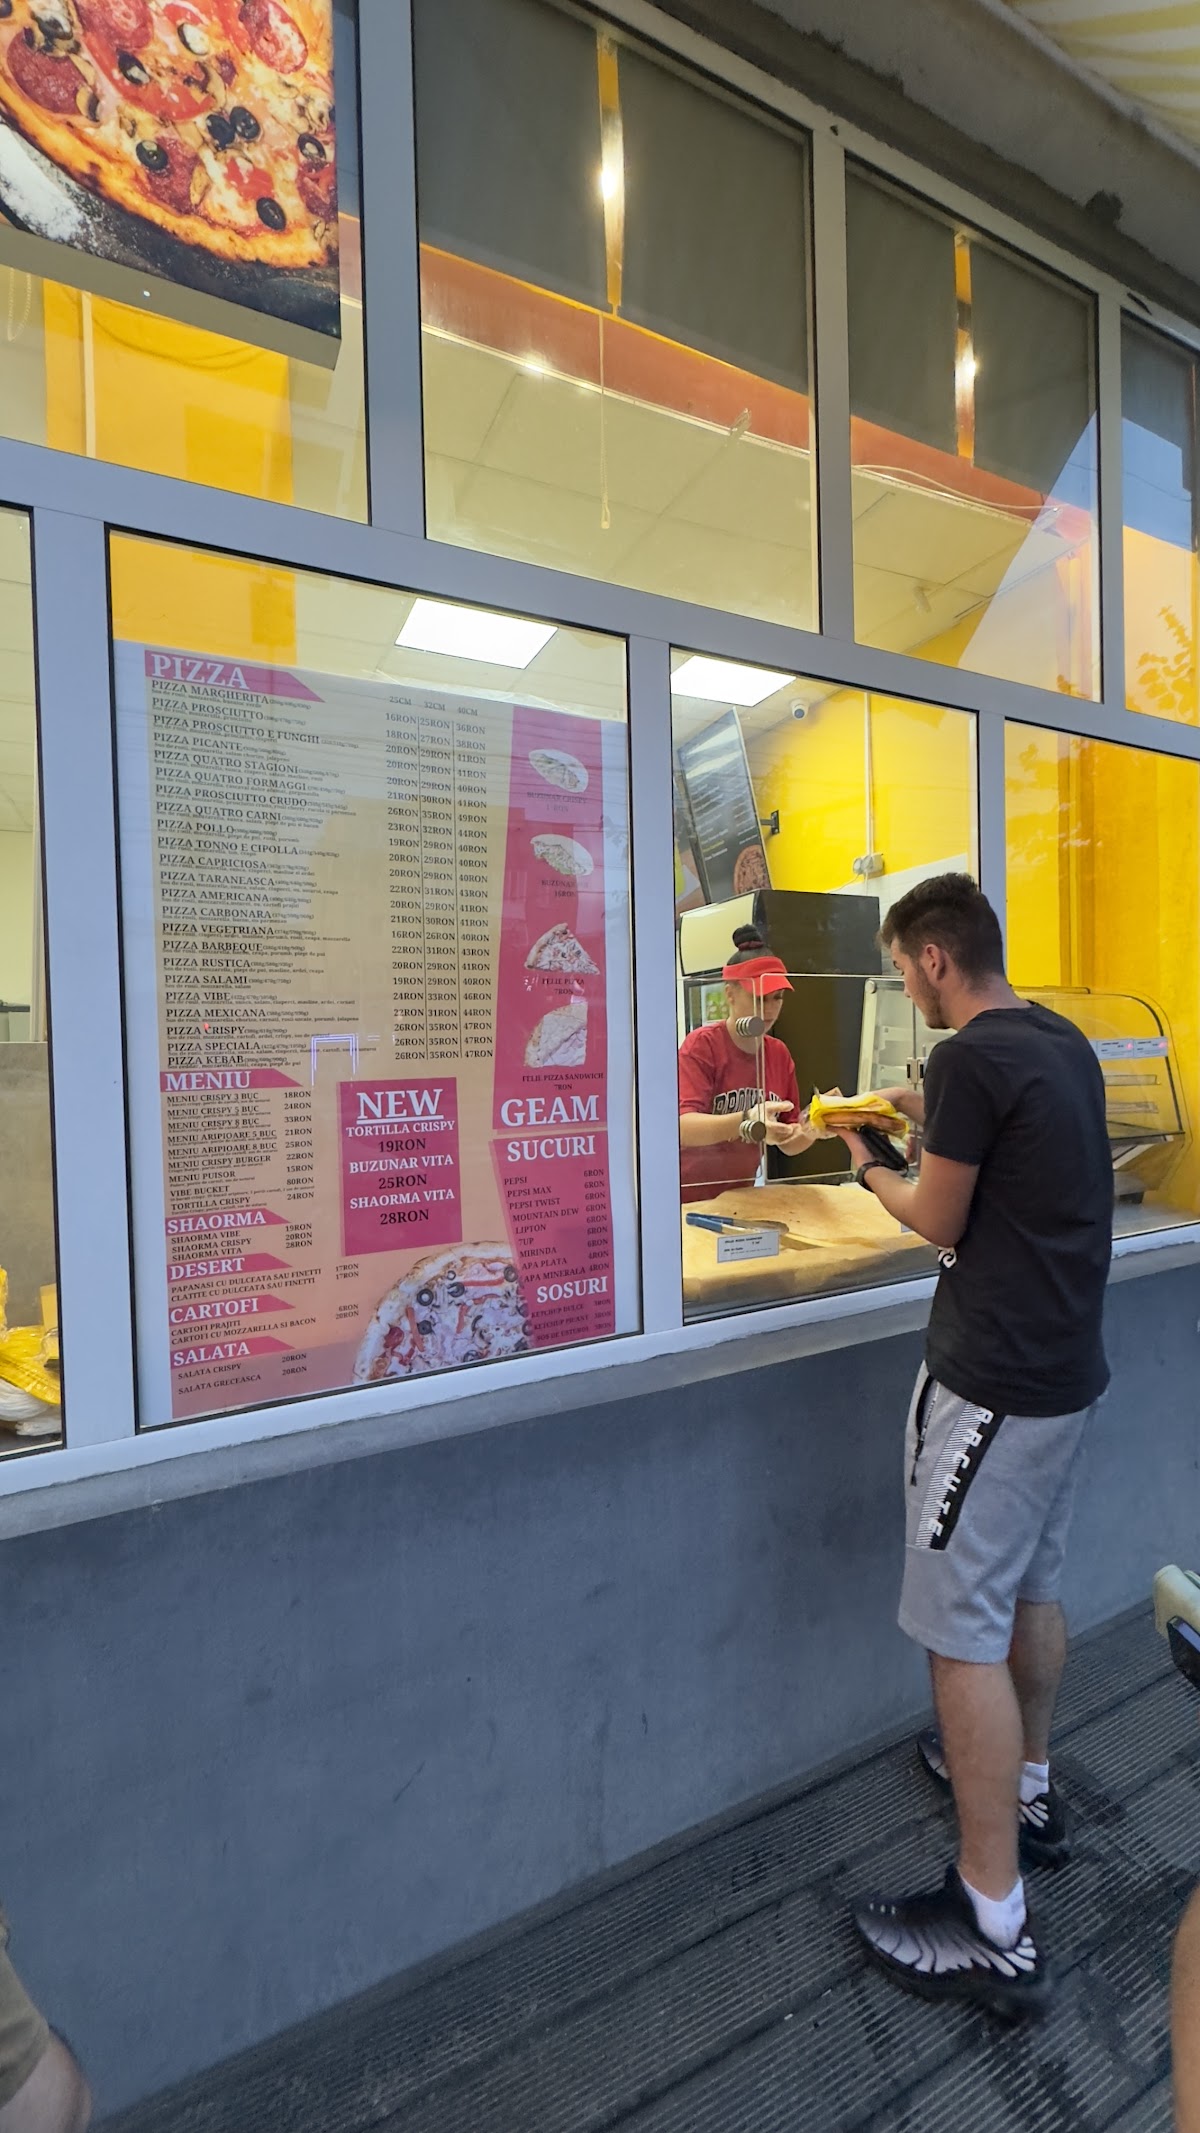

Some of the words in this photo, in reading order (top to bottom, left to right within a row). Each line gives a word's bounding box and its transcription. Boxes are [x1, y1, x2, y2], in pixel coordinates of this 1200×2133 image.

[151, 654, 249, 689] PIZZA
[152, 680, 187, 693] PIZZA
[191, 686, 269, 704] MARGHERITA
[153, 698, 188, 711] PIZZA
[192, 703, 264, 720] PROSCIUTTO
[154, 715, 189, 728] PIZZA
[193, 720, 264, 737] PROSCIUTTO
[278, 731, 320, 744] FUNGHI
[154, 733, 189, 745] PIZZA
[193, 738, 243, 751] PICANTE
[154, 751, 189, 762] PIZZA
[193, 755, 241, 768] QUATRO
[245, 761, 298, 774] STAGIONI
[156, 767, 191, 780] PIZZA
[195, 772, 243, 785] QUATRO
[247, 778, 307, 791] FORMAGGI
[156, 784, 191, 797] PIZZA
[195, 789, 266, 803] PROSCIUTTO
[270, 795, 307, 806] CRUDO
[156, 802, 191, 813] PIZZA
[195, 806, 243, 818] QUATRO
[247, 811, 281, 821] CARNI
[157, 819, 192, 831] PIZZA
[196, 823, 234, 833] POLLO
[158, 837, 193, 848] PIZZA
[196, 840, 237, 850] TONNO
[251, 844, 298, 855] CIPOLLA
[160, 854, 194, 865] PIZZA
[160, 871, 195, 882] PIZZA
[161, 889, 196, 899] PIZZA
[201, 892, 269, 902] AMERICANA
[163, 906, 197, 916] PIZZA
[201, 909, 272, 919] CARBONARA
[163, 923, 197, 933] PIZZA
[163, 941, 198, 950] PIZZA
[202, 943, 263, 952] BARBEQUE
[164, 958, 198, 967] PIZZA
[202, 959, 250, 967] RUSTICA
[165, 975, 200, 984] PIZZA
[203, 976, 247, 984] SALAMI
[166, 993, 200, 1001] PIZZA
[166, 1009, 201, 1018] PIZZA
[204, 1009, 266, 1017] MEXICANA
[167, 1027, 201, 1035] PIZZA
[205, 1027, 245, 1035] CRISPY
[168, 1043, 201, 1052] PIZZA
[205, 1042, 260, 1050] SPECIALA
[168, 1057, 202, 1065] PIZZA
[206, 1056, 244, 1064] KEBAB
[165, 1071, 251, 1091] MENIU
[357, 1089, 443, 1119] NEW
[167, 1109, 198, 1117] MENIU
[201, 1107, 232, 1115] CRISPY
[501, 1095, 599, 1127] GEAM
[168, 1122, 198, 1130] MENIU
[201, 1120, 232, 1128] CRISPY
[284, 1115, 311, 1123] 33RON
[285, 1128, 312, 1136] 21RON
[346, 1124, 409, 1137] TORTILLA
[413, 1121, 455, 1132] CRISPY
[168, 1135, 199, 1143] MENIU
[201, 1132, 250, 1140] ARIPIOARE
[168, 1148, 199, 1156] MENIU
[201, 1144, 250, 1153] ARIPIOARE
[379, 1138, 426, 1152] 19RON
[507, 1135, 596, 1162] SUCURI
[169, 1161, 199, 1169] MENIU
[202, 1158, 233, 1167] CRISPY
[236, 1155, 271, 1163] BURGER
[350, 1157, 418, 1173] BUZUNAR
[422, 1154, 454, 1166] VITA
[169, 1174, 200, 1182] MENIU
[203, 1171, 235, 1179] PUISOR
[584, 1169, 604, 1177] 6RON
[379, 1174, 427, 1189] 25RON
[504, 1176, 527, 1185] PEPSI
[170, 1189, 192, 1197] VIBE
[194, 1186, 230, 1195] BUCKET
[287, 1192, 314, 1200] 24RON
[508, 1188, 530, 1197] PEPSI
[533, 1187, 551, 1195] MAX
[171, 1201, 217, 1210] TORTILLA
[220, 1197, 250, 1206] CRISPY
[350, 1193, 420, 1209] SHAORMA
[424, 1189, 455, 1200] VITA
[167, 1212, 266, 1234] SHAORMA
[380, 1209, 429, 1225] 28RON
[286, 1223, 312, 1231] 19RON
[516, 1224, 546, 1234] LIPTON
[171, 1233, 217, 1244] SHAORMA
[286, 1232, 312, 1240] 20RON
[172, 1242, 218, 1253] SHAORMA
[221, 1239, 251, 1247] CRISPY
[286, 1240, 312, 1248] 28RON
[173, 1251, 218, 1262] SHAORMA
[520, 1247, 556, 1258] MIRINDA
[170, 1258, 245, 1280] DESERT
[336, 1264, 359, 1272] 17RON
[172, 1282, 213, 1293] PAPANASI
[229, 1275, 272, 1286] DULCEATA
[292, 1269, 321, 1278] FINETTI
[537, 1276, 607, 1303] SOSURI
[170, 1299, 258, 1323] CARTOFI
[171, 1325, 208, 1336] CARTOFI
[211, 1320, 240, 1330] PRAJITI
[174, 1342, 250, 1366] SALATA
[282, 1354, 307, 1362] 20RON
[178, 1369, 210, 1379] SALATA
[213, 1364, 241, 1373] CRISPY
